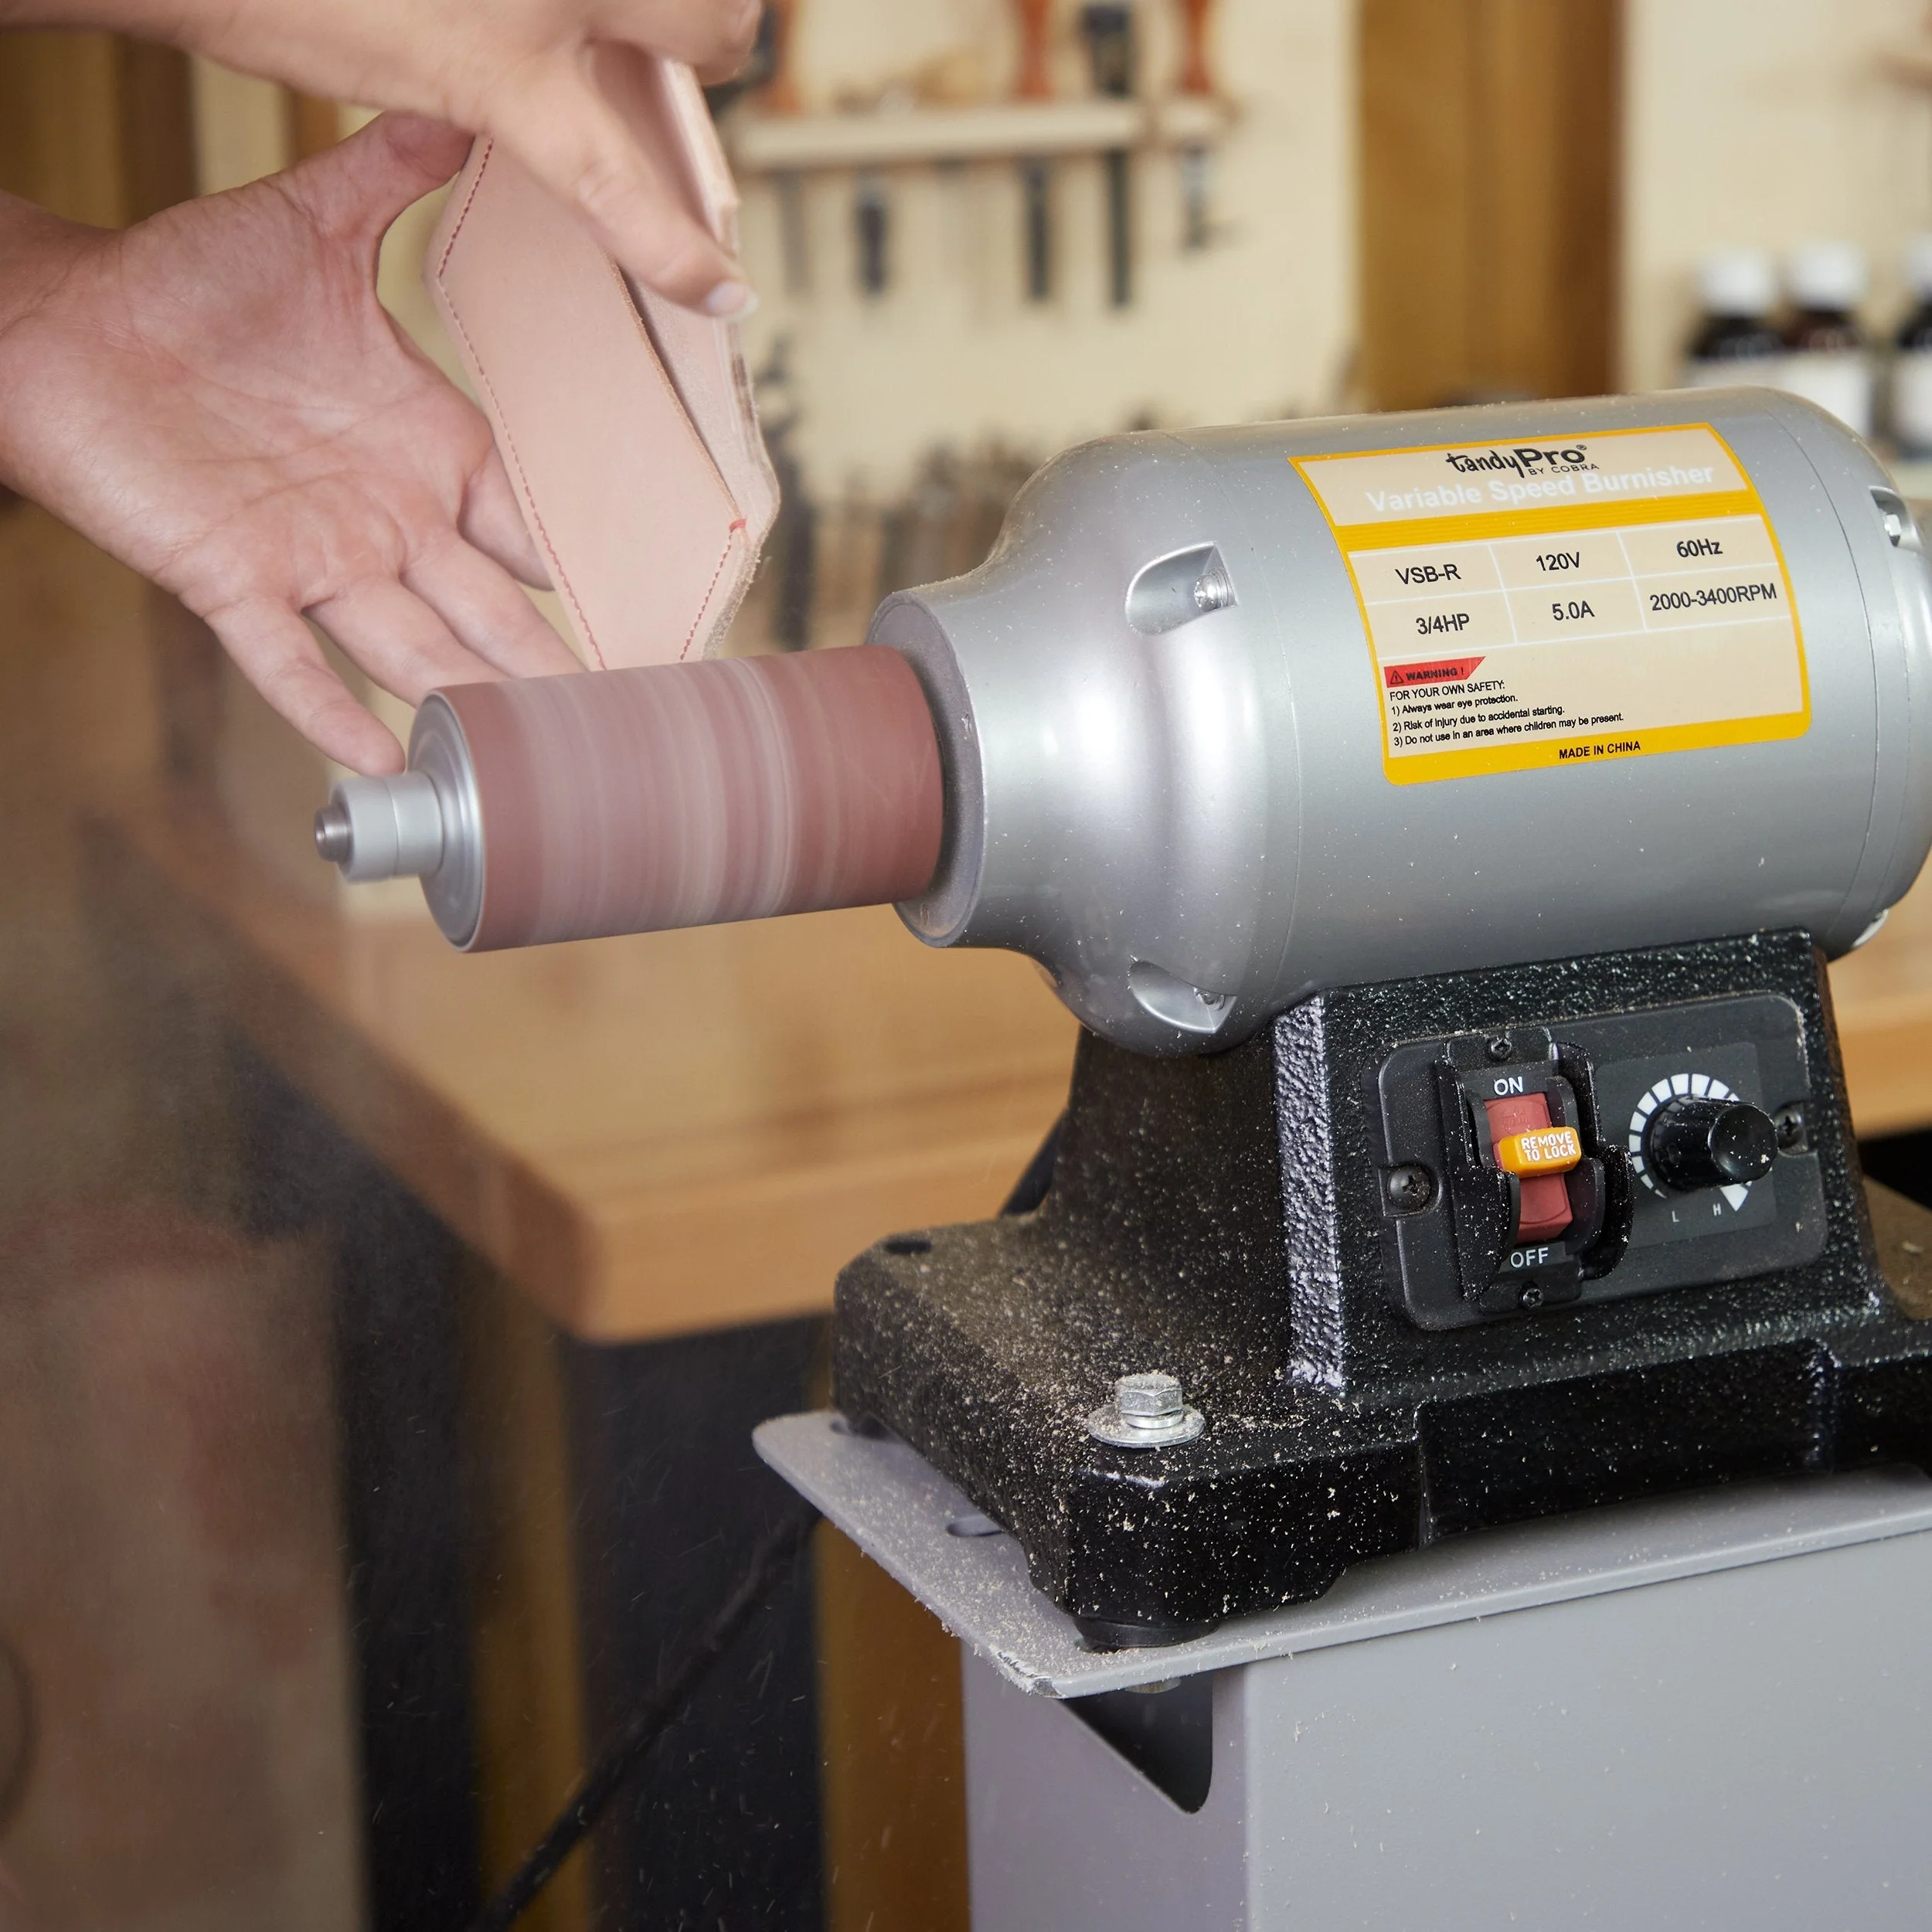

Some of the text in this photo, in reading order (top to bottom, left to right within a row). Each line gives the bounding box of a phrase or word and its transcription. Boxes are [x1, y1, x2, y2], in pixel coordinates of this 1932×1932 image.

[1552, 464, 1600, 473] COBRA
[1365, 466, 1714, 512] Variable Speed Burnisher
[1676, 539, 1723, 557] 60Hz
[1536, 552, 1580, 571] 120V
[1395, 563, 1461, 584] VSB-R
[1650, 583, 1777, 611] 2000-3400RPM
[1552, 600, 1595, 621] 5.0A
[1416, 613, 1469, 634] 3/4HP
[1406, 668, 1458, 681] WARNING
[1389, 680, 1505, 701] FOR YOUR OWN SAFETY:
[1392, 706, 1400, 716] 1)
[1402, 703, 1432, 714] Always
[1458, 700, 1472, 709] eye
[1475, 695, 1518, 707] protection.
[1393, 723, 1401, 733] 2)
[1404, 721, 1422, 730] Risk
[1425, 719, 1433, 727] of
[1435, 718, 1457, 728] injury
[1460, 716, 1475, 724] due
[1488, 708, 1529, 720] accidental
[1532, 706, 1564, 716] starting.
[1394, 737, 1403, 747] 3)
[1406, 736, 1417, 744] Do
[1420, 733, 1433, 743] not
[1436, 733, 1450, 741] use
[1453, 730, 1460, 740] in
[1496, 725, 1522, 734] where
[1524, 720, 1556, 731] children
[1560, 719, 1576, 729] may
[1591, 713, 1624, 726] present.
[1560, 740, 1641, 759] MADE IN CHINA
[1494, 1077, 1523, 1095] ON
[1521, 1131, 1573, 1150] REMOVE
[1524, 1144, 1576, 1162] TO LOCK
[1672, 1202, 1722, 1223] L H
[1511, 1247, 1549, 1268] OFF
